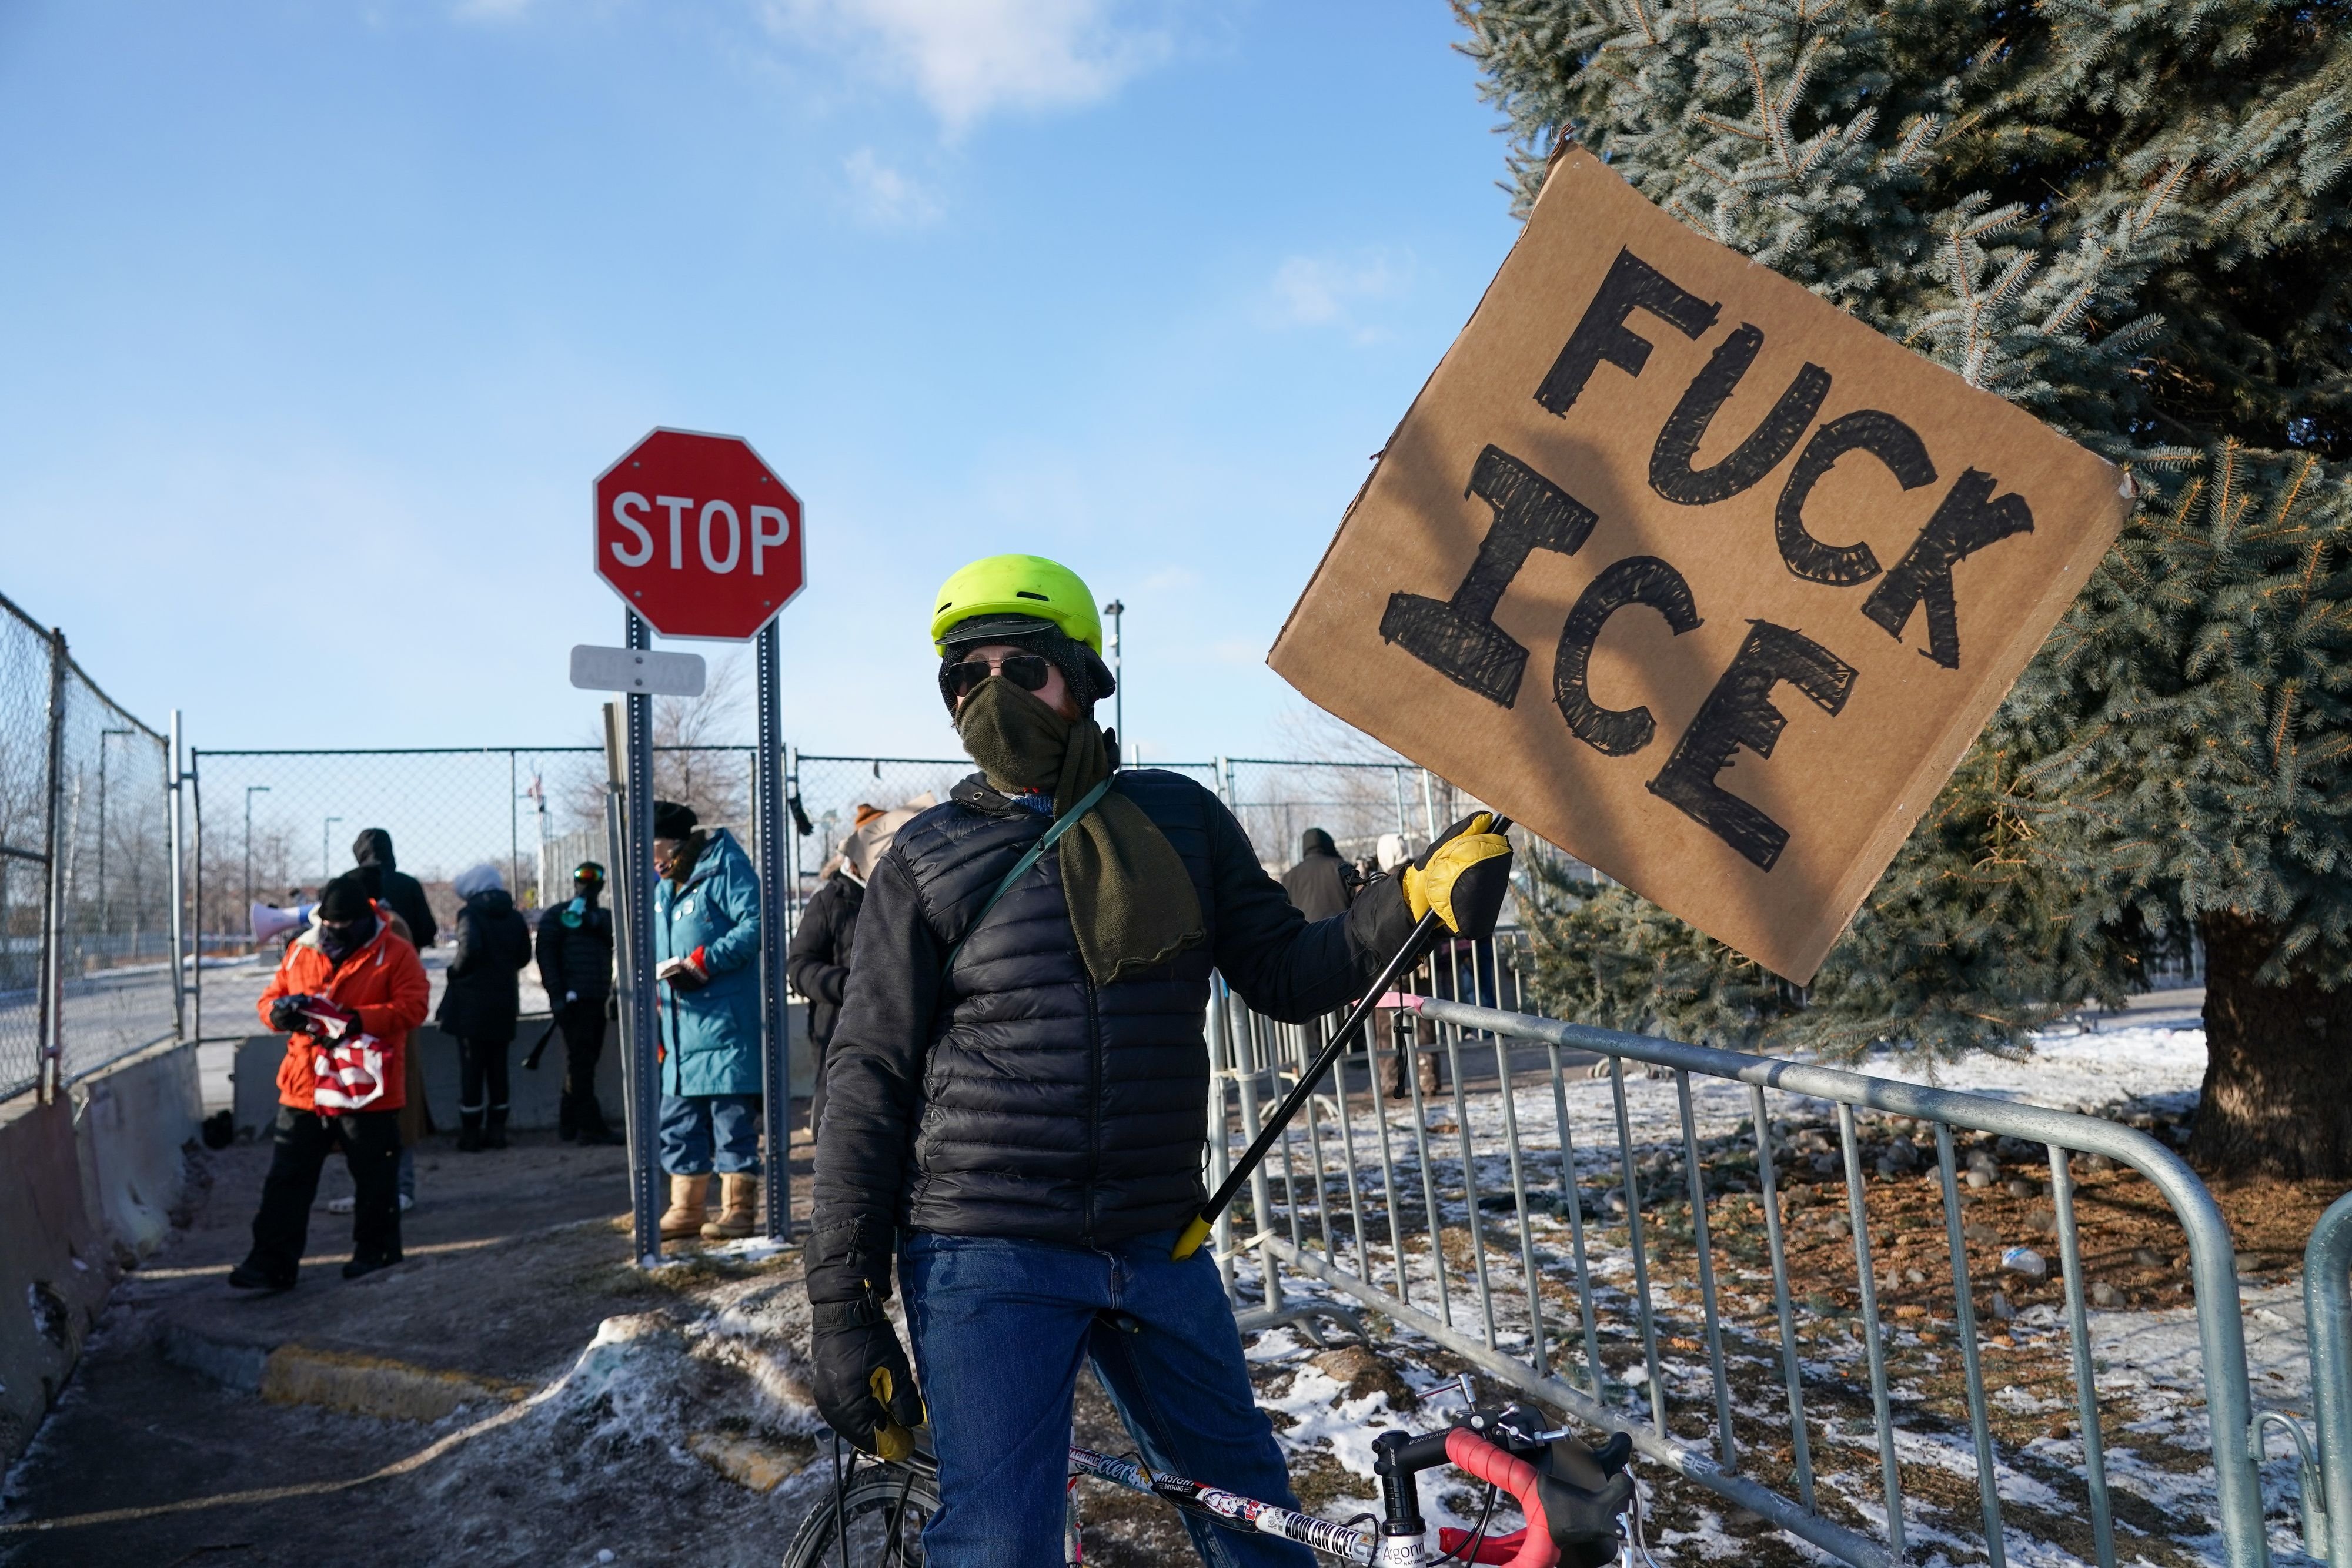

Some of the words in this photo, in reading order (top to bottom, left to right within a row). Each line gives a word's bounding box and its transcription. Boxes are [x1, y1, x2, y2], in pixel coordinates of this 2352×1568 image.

[1533, 244, 2034, 669] FUCK
[610, 491, 790, 576] STOP
[1379, 444, 1859, 873] ICE
[1164, 1483, 1184, 1492] BREWING
[1285, 1512, 1330, 1551] ABOLISH
[1331, 1526, 1358, 1559] ICE!
